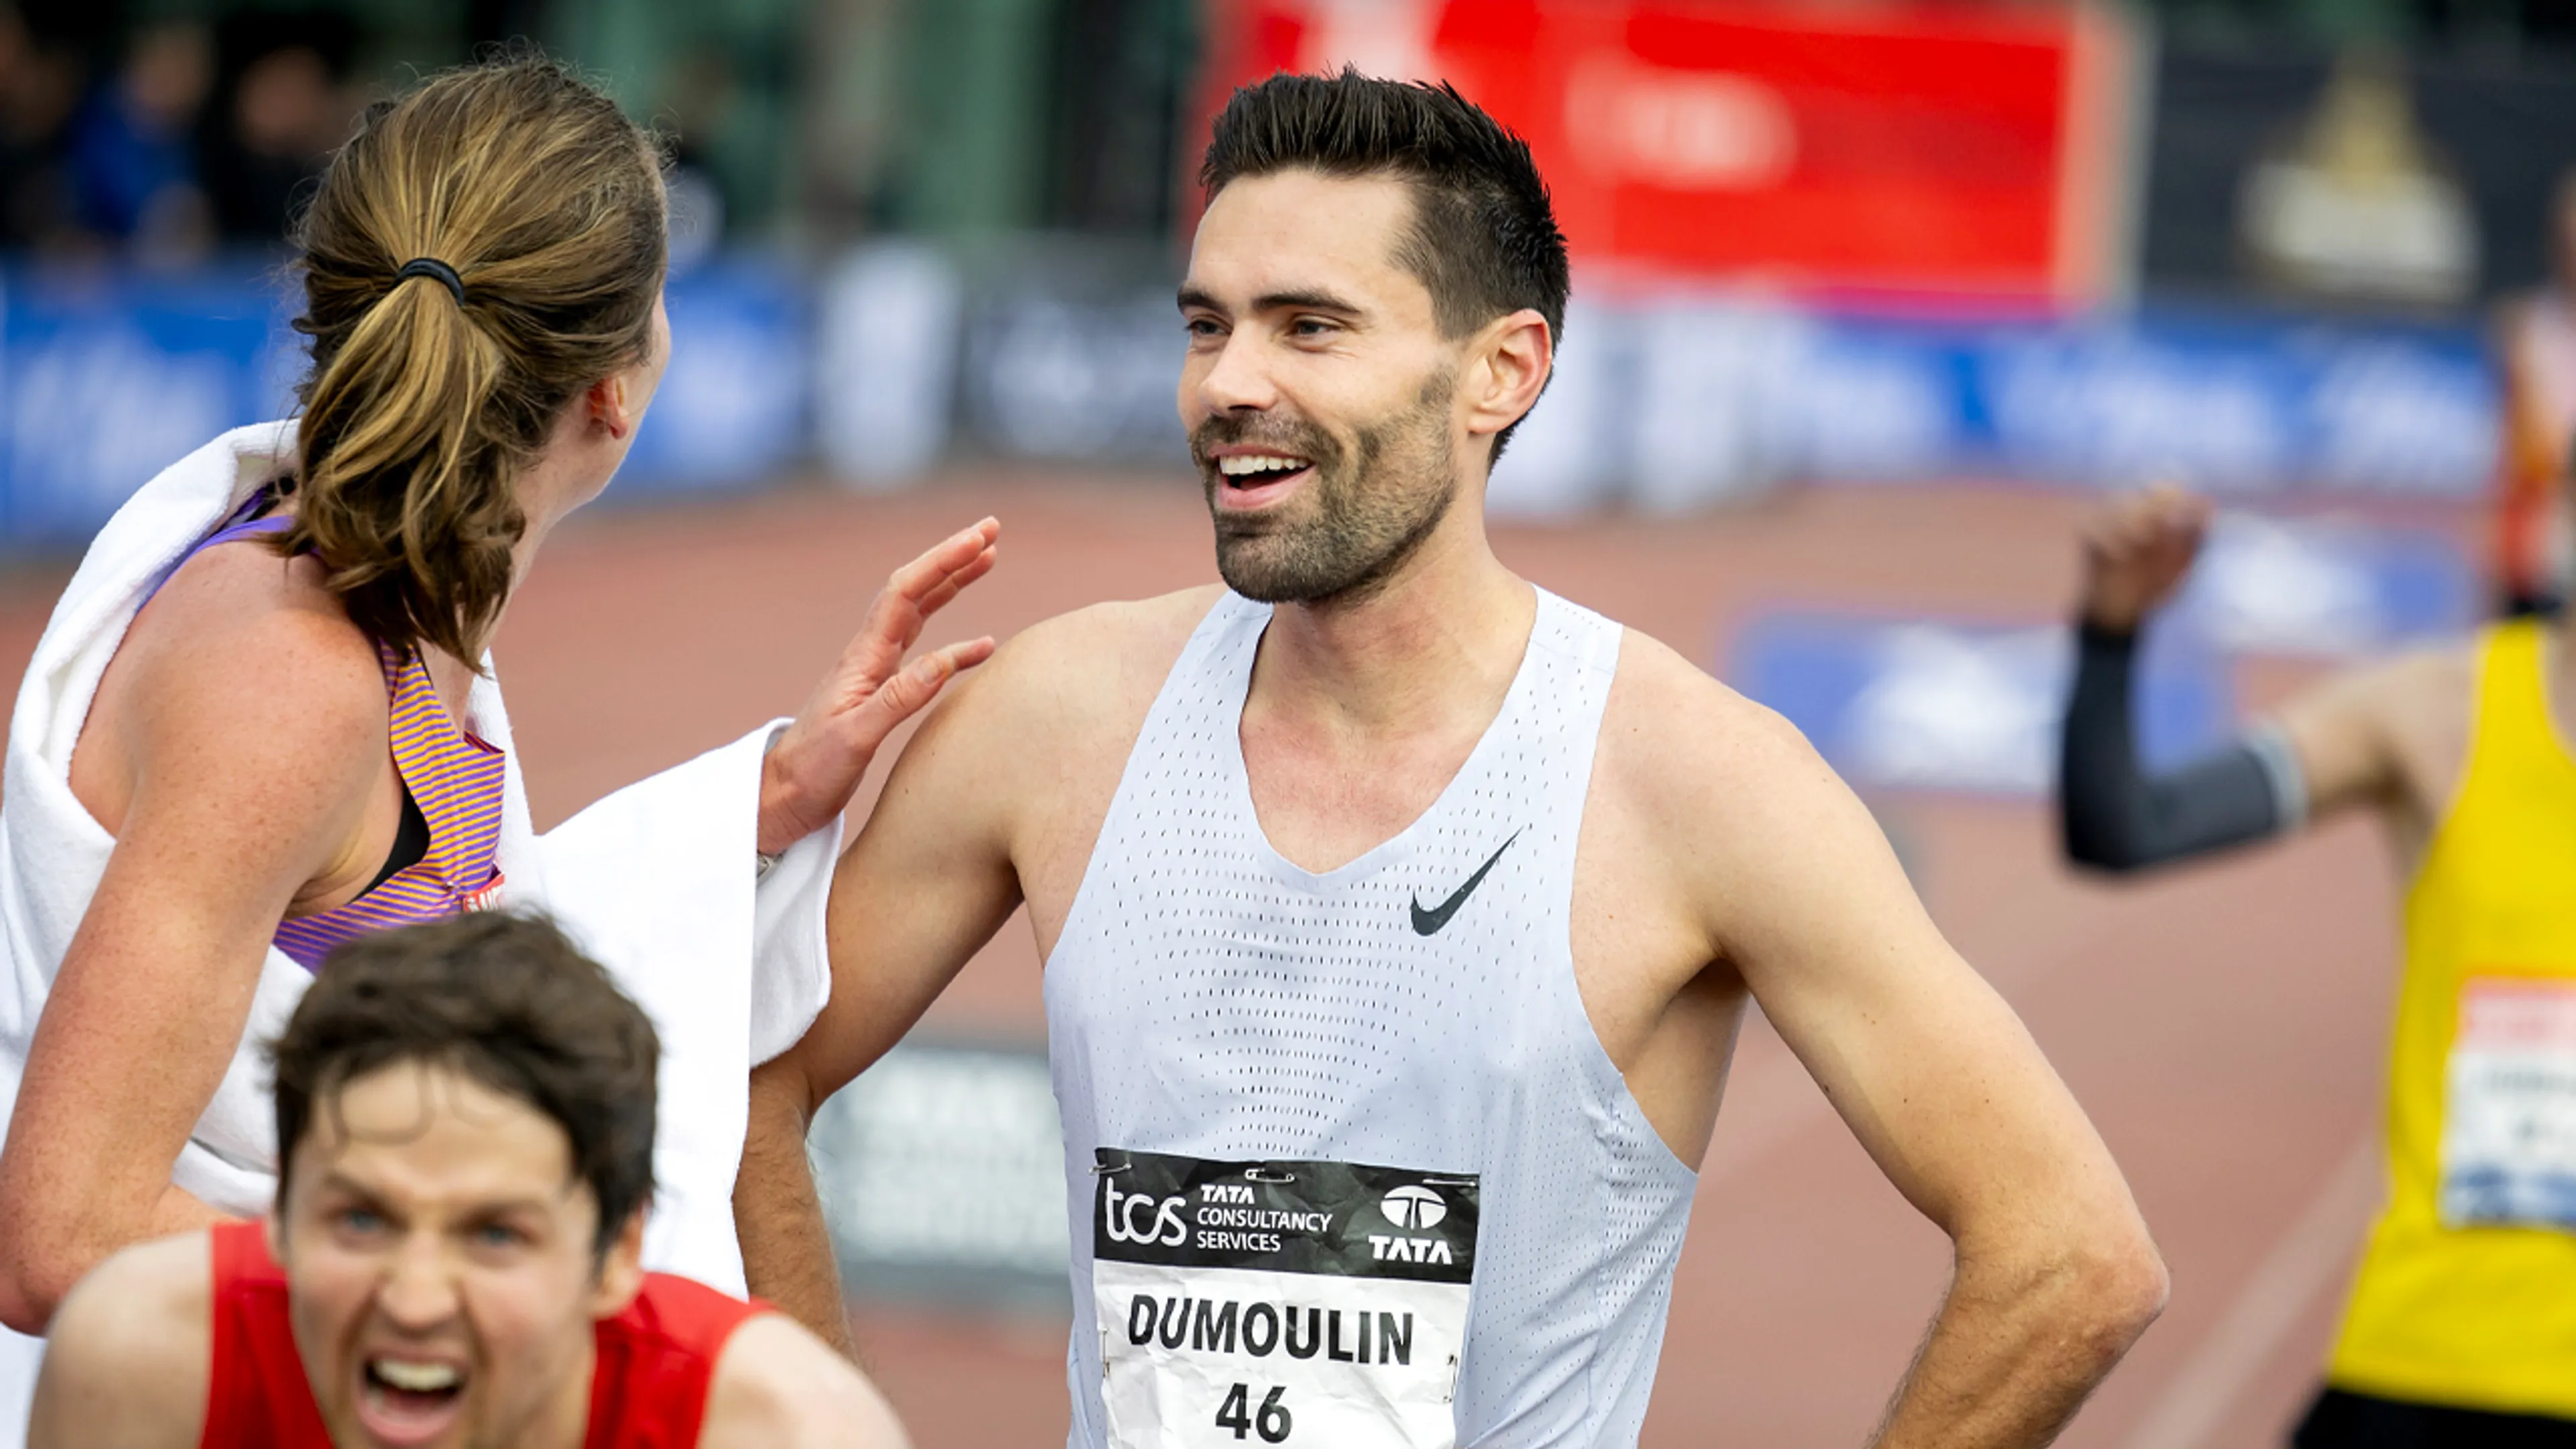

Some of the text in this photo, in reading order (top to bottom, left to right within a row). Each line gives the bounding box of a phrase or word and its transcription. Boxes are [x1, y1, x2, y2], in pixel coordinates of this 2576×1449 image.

[1201, 1185, 1255, 1204] TATA
[1106, 1177, 1187, 1246] tcs
[1197, 1208, 1332, 1232] CONSULTANCY
[1197, 1230, 1281, 1252] SERVICES
[1368, 1235, 1452, 1265] TATA
[1128, 1294, 1413, 1365] DUMOULIN
[1215, 1382, 1292, 1444] 46
